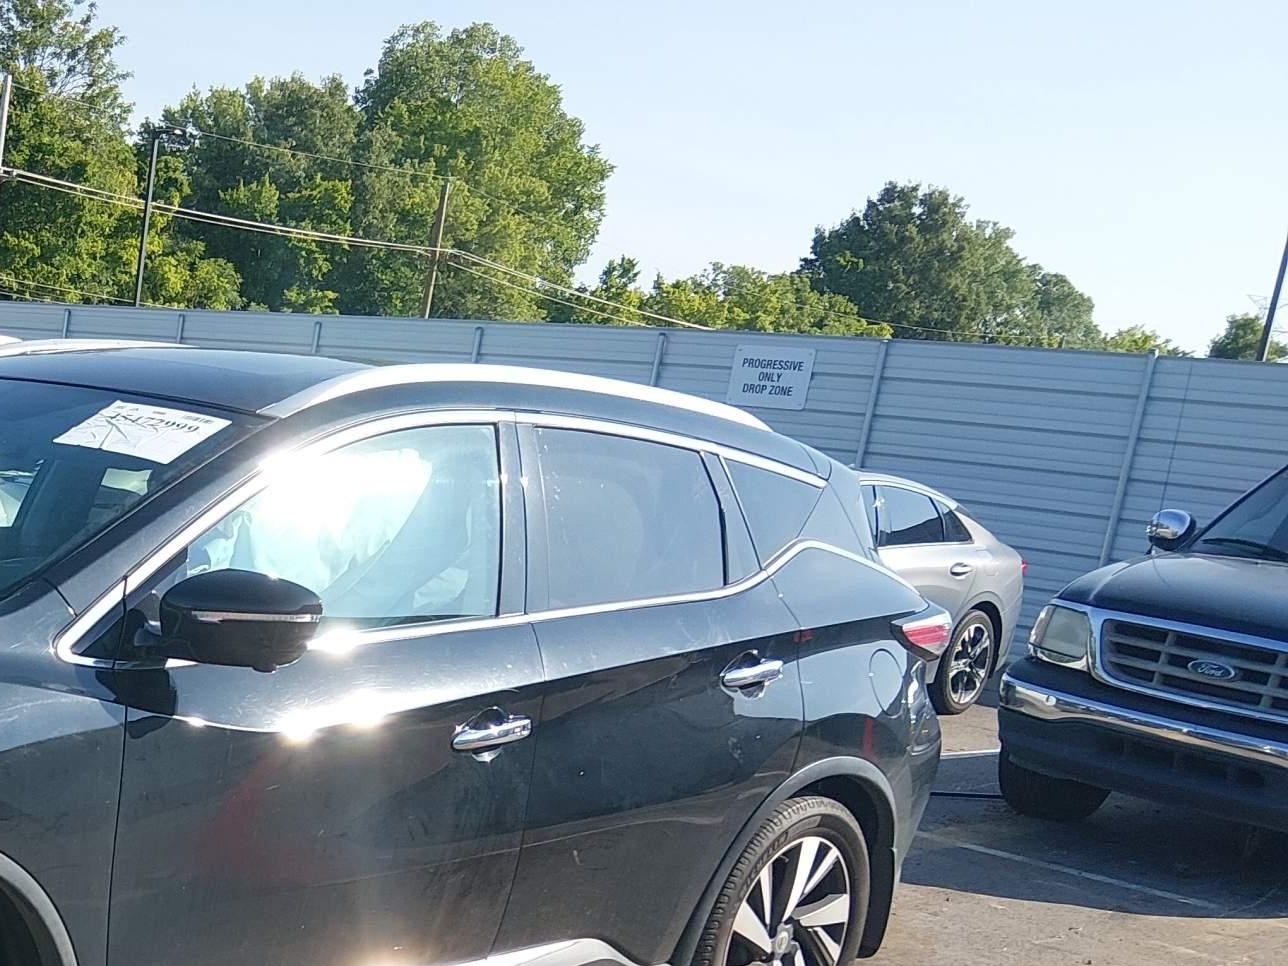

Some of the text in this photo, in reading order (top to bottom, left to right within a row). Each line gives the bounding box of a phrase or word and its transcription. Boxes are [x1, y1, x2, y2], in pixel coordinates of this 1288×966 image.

[742, 358, 804, 371] PROGRESSIVE
[758, 371, 782, 382] ONLY
[742, 383, 793, 396] DROP ZONE
